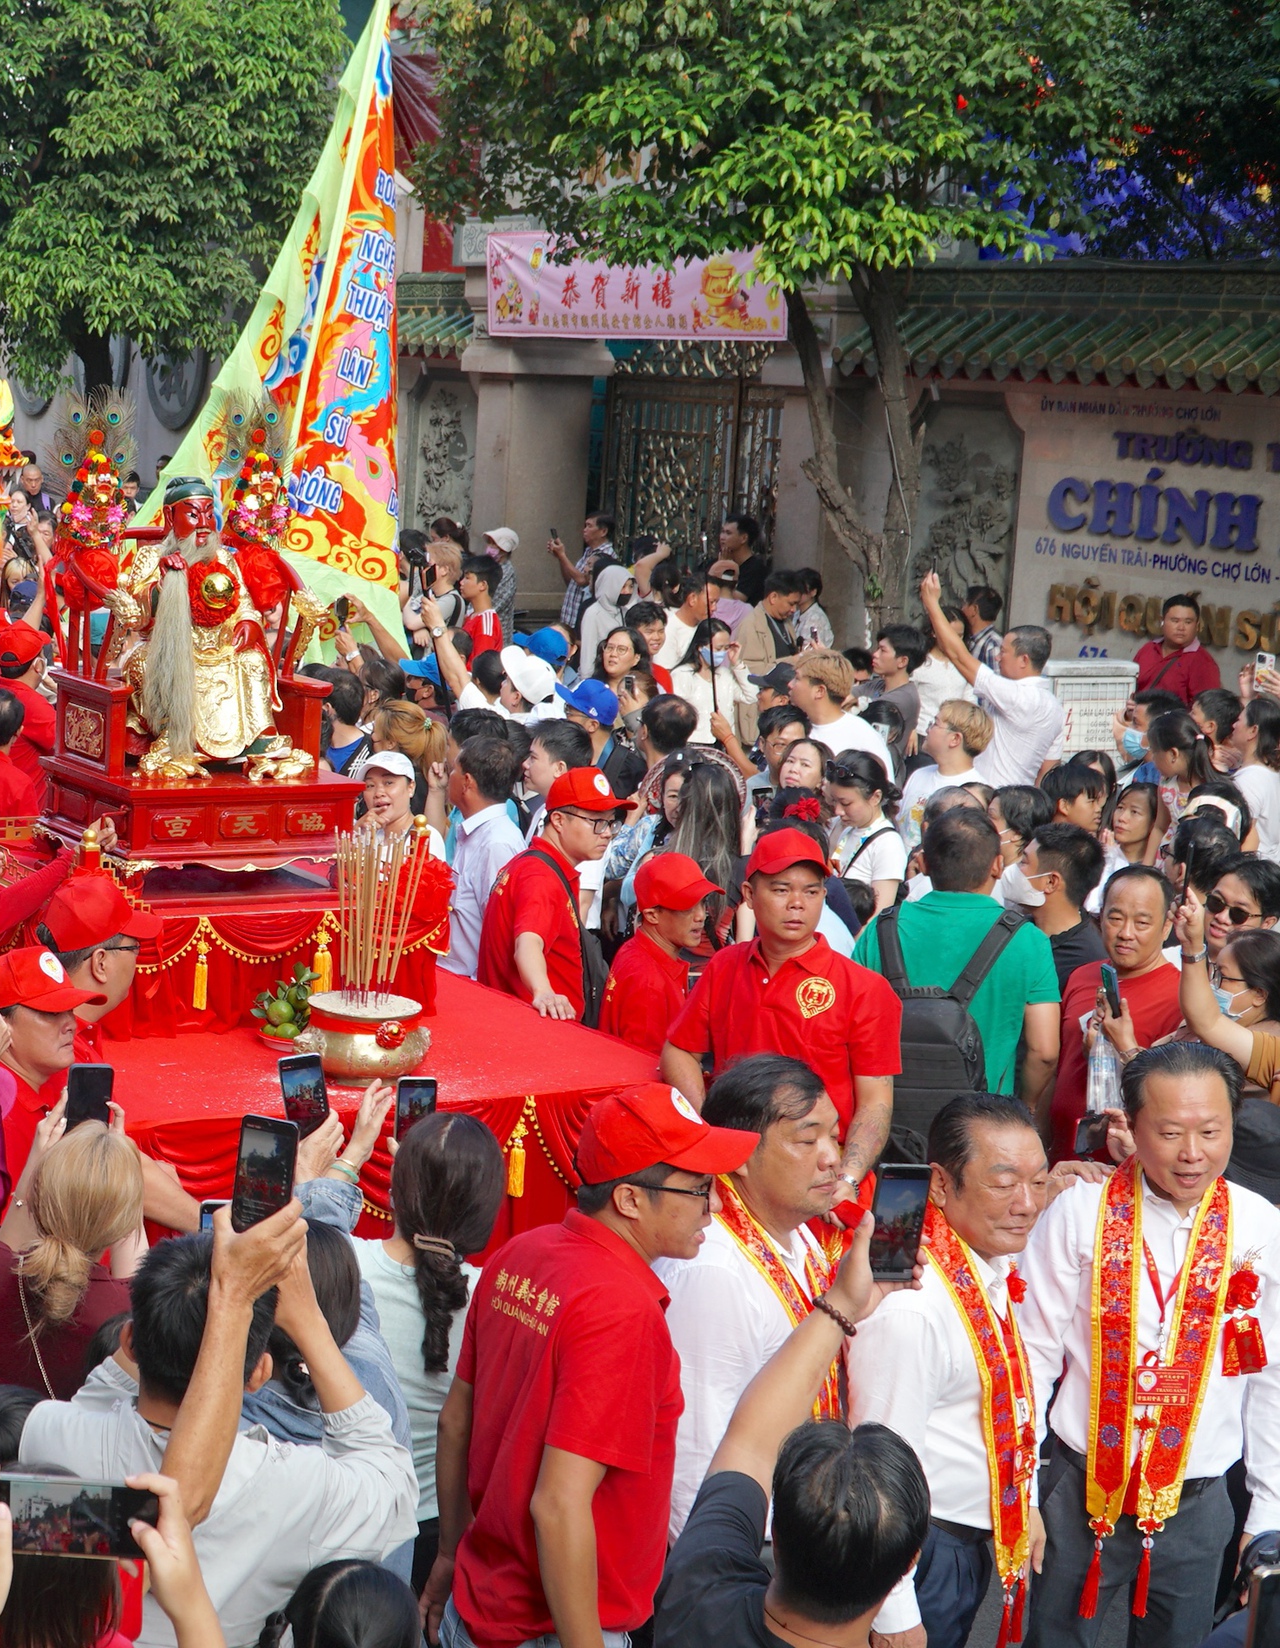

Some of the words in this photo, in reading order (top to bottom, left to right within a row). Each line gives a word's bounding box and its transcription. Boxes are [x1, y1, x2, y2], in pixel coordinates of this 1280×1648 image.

[344, 281, 394, 332] THUẬT
[561, 271, 675, 310] 恭賀新禧
[337, 346, 374, 389] LÂN
[324, 412, 352, 448] SƯ
[1175, 406, 1199, 423] CHỢ
[1200, 405, 1221, 421] LỚN
[1113, 427, 1254, 470] TRƯỜNG
[1047, 467, 1263, 552] CHÍNH
[1035, 536, 1057, 556] 676
[1061, 542, 1118, 565] NGUYỄN
[1211, 561, 1241, 583] CHỢ
[1244, 562, 1271, 584] LỚN
[1047, 576, 1117, 637] HỘI
[1119, 590, 1233, 648] QUN
[536, 1321, 549, 1337] AN
